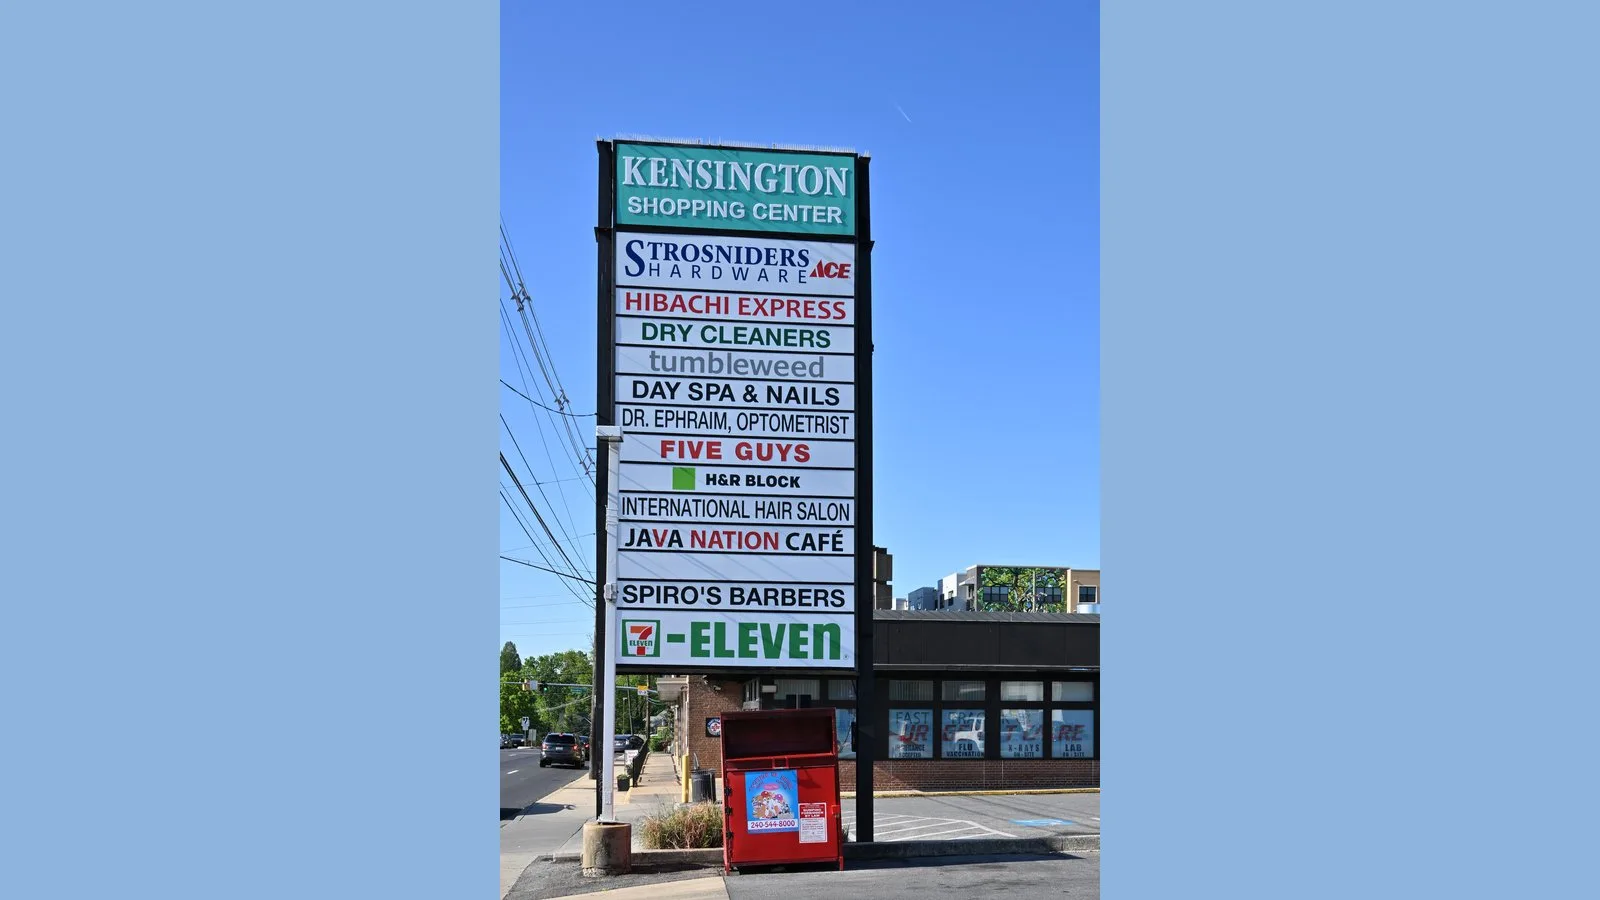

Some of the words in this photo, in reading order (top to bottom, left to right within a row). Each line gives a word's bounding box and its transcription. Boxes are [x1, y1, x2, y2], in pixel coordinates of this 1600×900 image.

[622, 156, 848, 196] KENSINGTON
[628, 197, 746, 219] SHOPPING
[752, 203, 843, 224] CENTER
[625, 240, 810, 276] STROSNIDERS
[810, 260, 851, 279] ACE
[649, 263, 807, 284] HARDWARE
[626, 292, 730, 315] HIBACHI
[738, 297, 846, 320] EXPRESS
[642, 322, 693, 342] DRY
[700, 325, 831, 348] CLEANERS
[650, 350, 824, 378] tumbleweed
[632, 380, 681, 400] DAY
[688, 382, 736, 402] SPA
[742, 384, 759, 403] &
[766, 386, 840, 406] NAILS
[622, 408, 648, 428] DR.
[655, 410, 732, 433] EPHRAIM,
[736, 412, 850, 434] OPTOMETRIST
[660, 440, 722, 460] FIVE
[735, 442, 810, 462] GUYS
[706, 473, 740, 486] H&R
[746, 475, 800, 488] BLOCK
[622, 497, 750, 519] INTERNATIONAL
[755, 500, 792, 520] HAIR
[797, 502, 850, 521] SALON
[625, 528, 684, 548] JAVA
[690, 530, 779, 550] NATION
[786, 530, 844, 552] CAFÉ
[622, 584, 722, 605] SPIRO'S
[730, 588, 845, 607] BARBERS
[630, 626, 652, 655] 7
[896, 712, 930, 724] FAST
[750, 820, 796, 829] 240-544-8000
